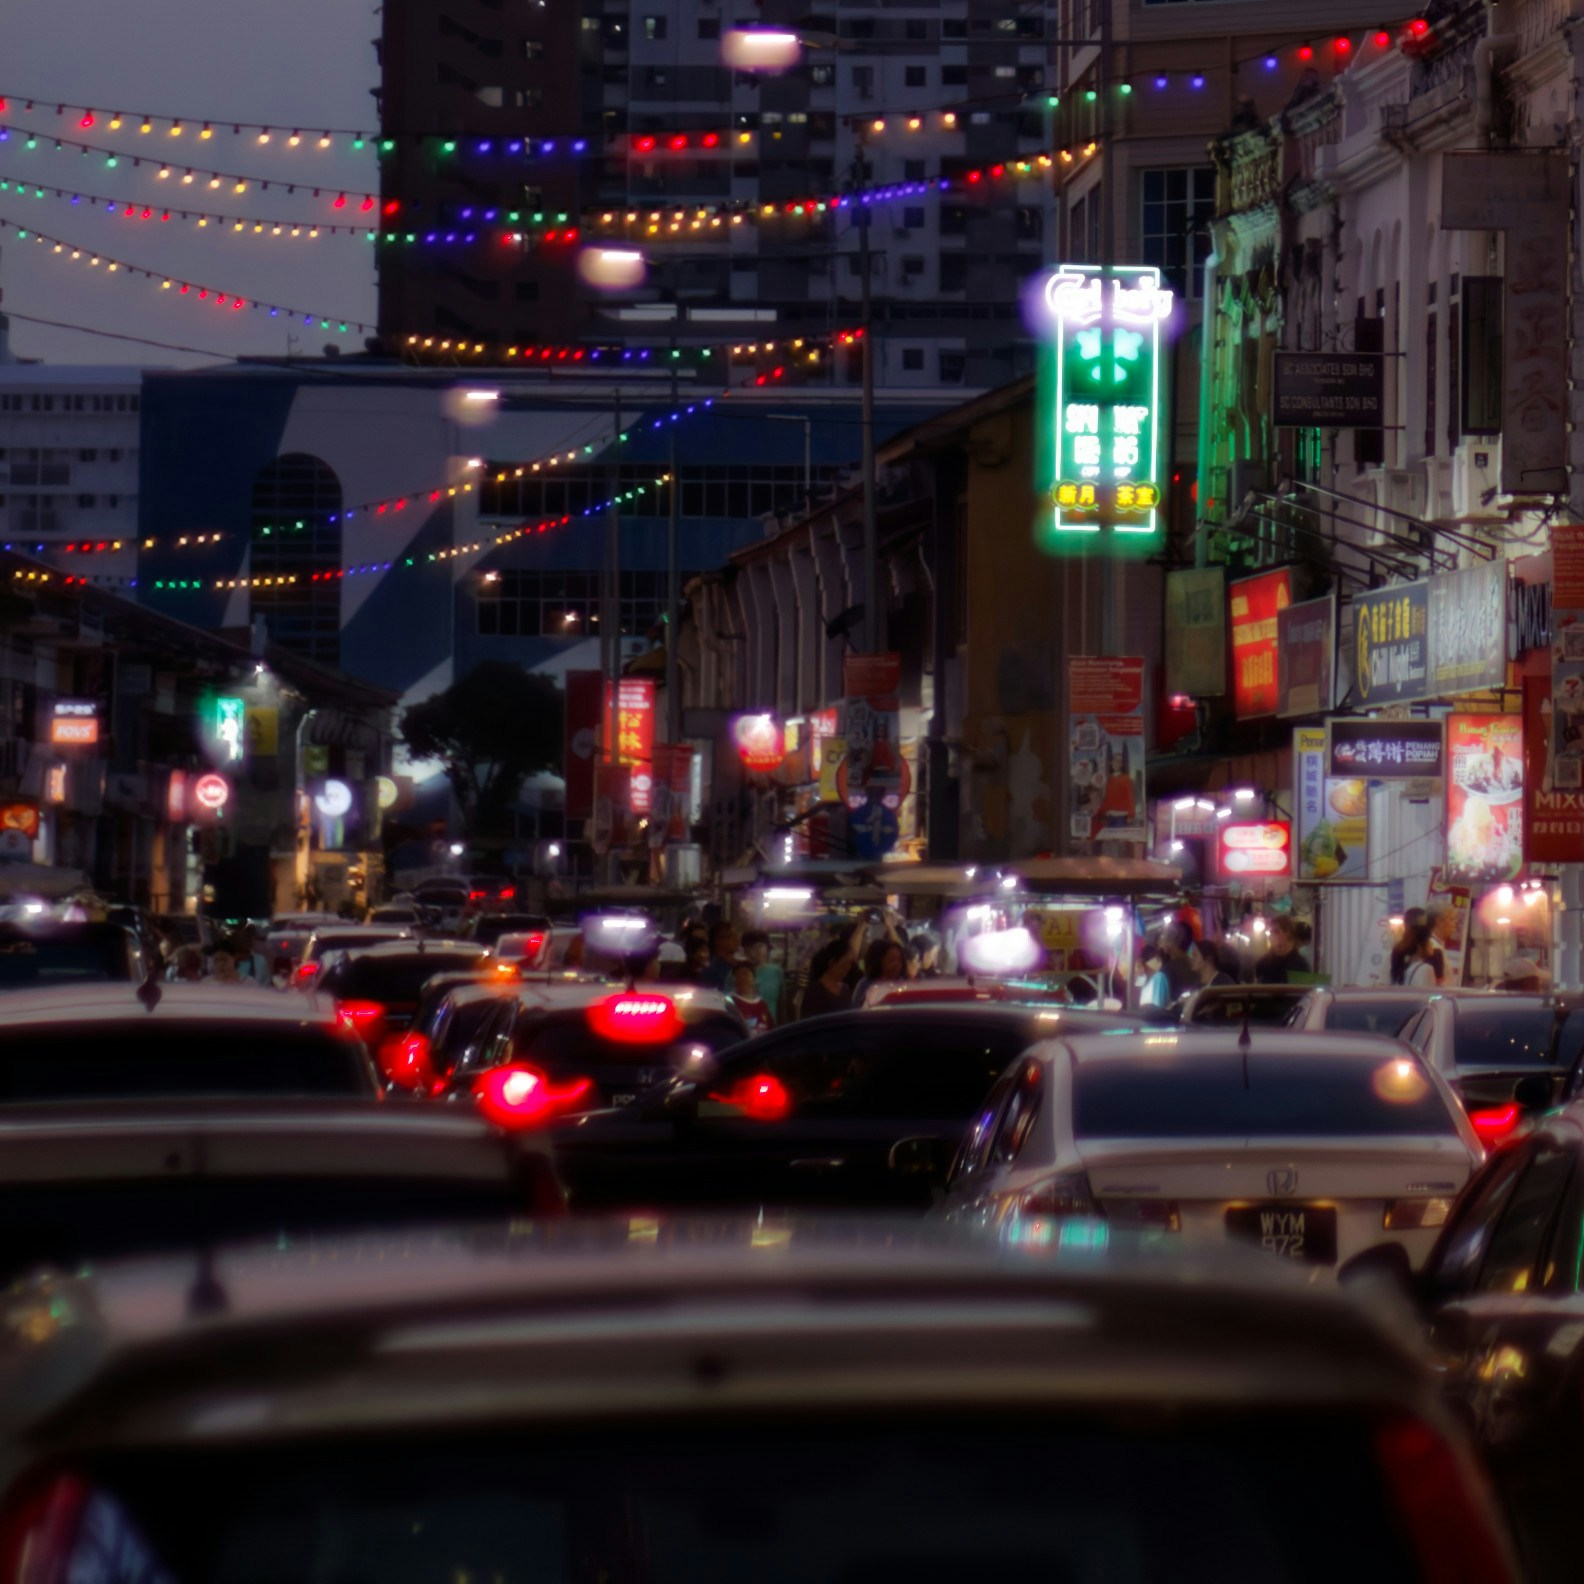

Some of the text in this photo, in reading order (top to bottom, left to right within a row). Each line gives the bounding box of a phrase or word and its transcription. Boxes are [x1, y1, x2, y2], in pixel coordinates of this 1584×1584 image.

[1405, 741, 1440, 750] PENANG
[1405, 750, 1438, 759] POPIAH
[1260, 1212, 1305, 1235] WYM
